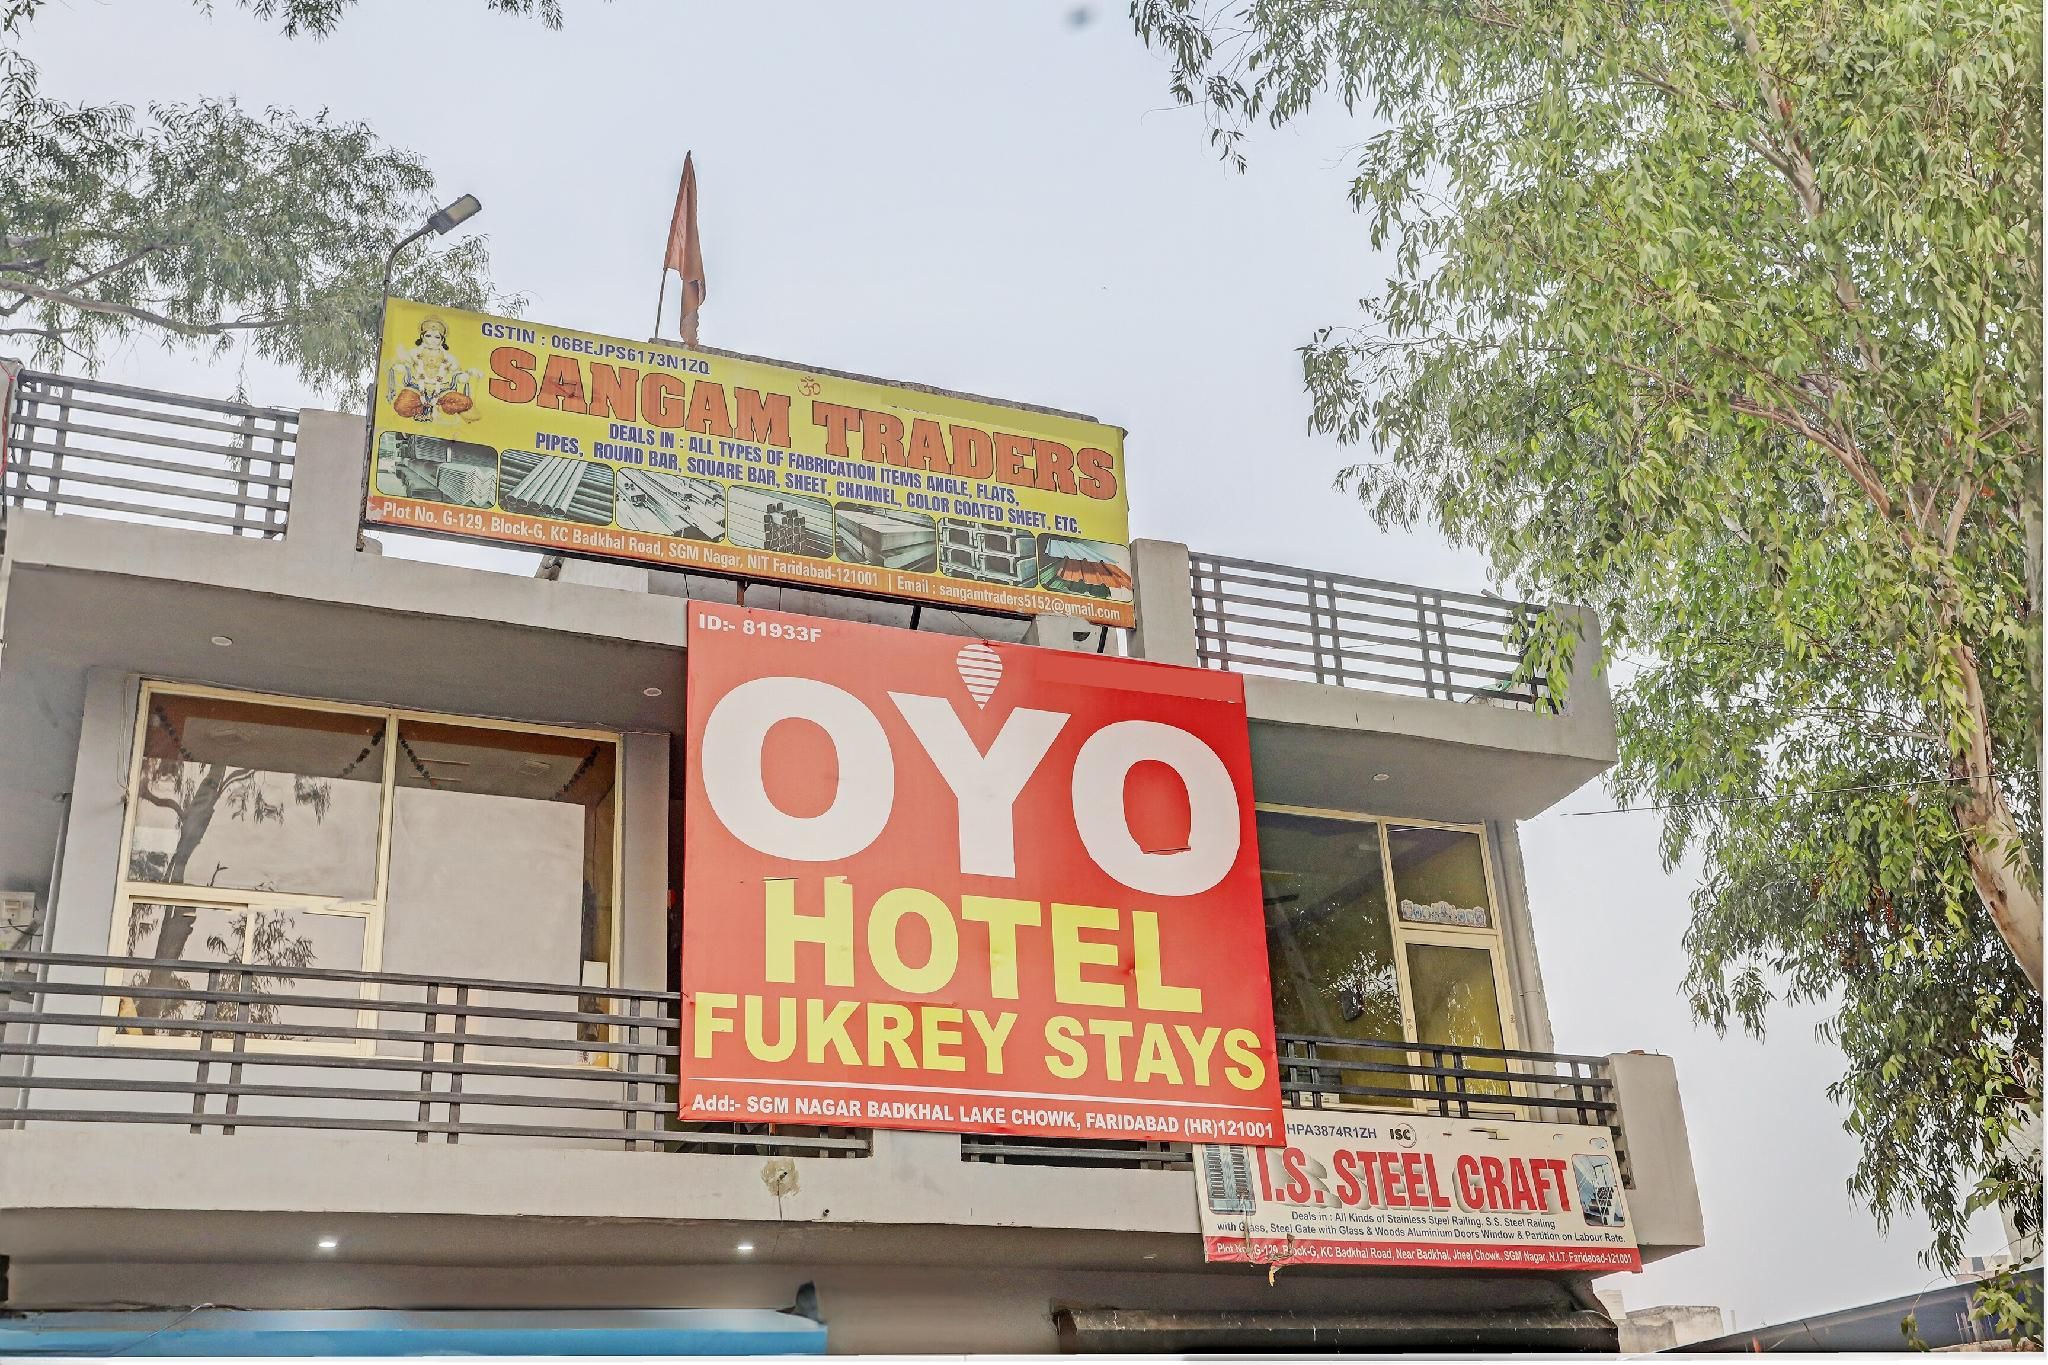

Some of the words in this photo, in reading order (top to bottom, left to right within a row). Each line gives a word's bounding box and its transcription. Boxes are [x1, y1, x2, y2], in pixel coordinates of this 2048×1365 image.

[482, 322, 535, 344] GSTIN
[489, 346, 791, 448] SANGAM
[812, 400, 1118, 500] TRADERS
[535, 431, 584, 458] PIPES,
[593, 441, 644, 465] ROUND
[650, 451, 682, 473] BAR,
[687, 457, 743, 481] SQUARE
[747, 466, 781, 488] BAR,
[784, 472, 832, 497] SHEET,
[836, 480, 902, 508] CHANNEL,
[907, 492, 950, 513] COLOR
[954, 499, 1004, 522] COATED
[1008, 508, 1051, 530] SHEET,
[1055, 515, 1082, 534] ETC.
[609, 423, 655, 446] DEALS
[660, 431, 675, 449] IN
[688, 436, 714, 456] ALL
[719, 440, 762, 464] TYPES
[766, 449, 784, 466] OF
[788, 452, 876, 482] FABRICATION
[880, 467, 922, 489] ITEMS
[926, 475, 973, 499] ANGLE,
[976, 483, 1020, 507] FLATS,
[383, 501, 411, 519] Plot
[415, 506, 437, 524] No.
[491, 517, 546, 540] Block-G,
[550, 525, 568, 542] KC
[573, 530, 624, 551] Badkhal
[630, 537, 664, 558] Road,
[668, 542, 699, 561] SGM
[703, 550, 744, 569] Nagar,
[747, 555, 770, 571] NIT
[773, 557, 879, 586] Faridabad-121001
[897, 575, 929, 594] Email
[939, 584, 1120, 621] sangamtraders5152@gmail.com
[699, 613, 736, 632] ID:-
[743, 619, 821, 643] 81933F
[701, 676, 1241, 897] OYO
[763, 875, 1202, 1013] HOTEL
[693, 991, 1018, 1075] FUKREY
[1044, 1015, 1266, 1090] STAYS
[692, 1094, 741, 1112] Add:-
[747, 1095, 789, 1114] SGM
[795, 1098, 861, 1117] NAGAR
[867, 1101, 953, 1121] BADKHAL
[959, 1106, 1006, 1124] LAKE
[1011, 1108, 1080, 1131] CHOWK,
[1086, 1113, 1179, 1133] FARIDABAD
[1184, 1118, 1273, 1139] (HR)121001
[1390, 1129, 1411, 1141] ISC
[1256, 1147, 1325, 1204] I.S.
[1333, 1149, 1452, 1208] STEEL
[1457, 1154, 1571, 1212] CRAFT
[1217, 1222, 1237, 1232] with
[1270, 1223, 1293, 1233] Steel
[1295, 1224, 1316, 1234] Gate
[1319, 1224, 1337, 1234] with
[1339, 1225, 1365, 1236] Glass
[1374, 1226, 1405, 1237] Woods
[1407, 1227, 1453, 1238] Aluminium
[1453, 1228, 1480, 1239] Doors
[1481, 1229, 1515, 1240] Window
[1525, 1230, 1561, 1241] Partition
[1562, 1233, 1573, 1241] on
[1575, 1232, 1603, 1242] Labour
[1291, 1211, 1317, 1222] Deals
[1319, 1212, 1327, 1221] in
[1335, 1213, 1346, 1222] All
[1349, 1213, 1375, 1223] Kinds
[1376, 1214, 1385, 1223] of
[1387, 1214, 1426, 1225] Stainless
[1428, 1215, 1449, 1226] Steel
[1504, 1218, 1525, 1228] Steel
[1527, 1218, 1556, 1230] Railing
[1217, 1243, 1234, 1253] Plot
[1320, 1246, 1332, 1258] KC
[1335, 1246, 1369, 1258] Badkhal
[1370, 1247, 1394, 1260] Road,
[1396, 1248, 1415, 1259] Near
[1417, 1248, 1451, 1261] Badkhal,
[1504, 1250, 1523, 1261] SGM
[1524, 1252, 1548, 1264] Nagar,
[1569, 1252, 1632, 1264] Faridabad-121001
